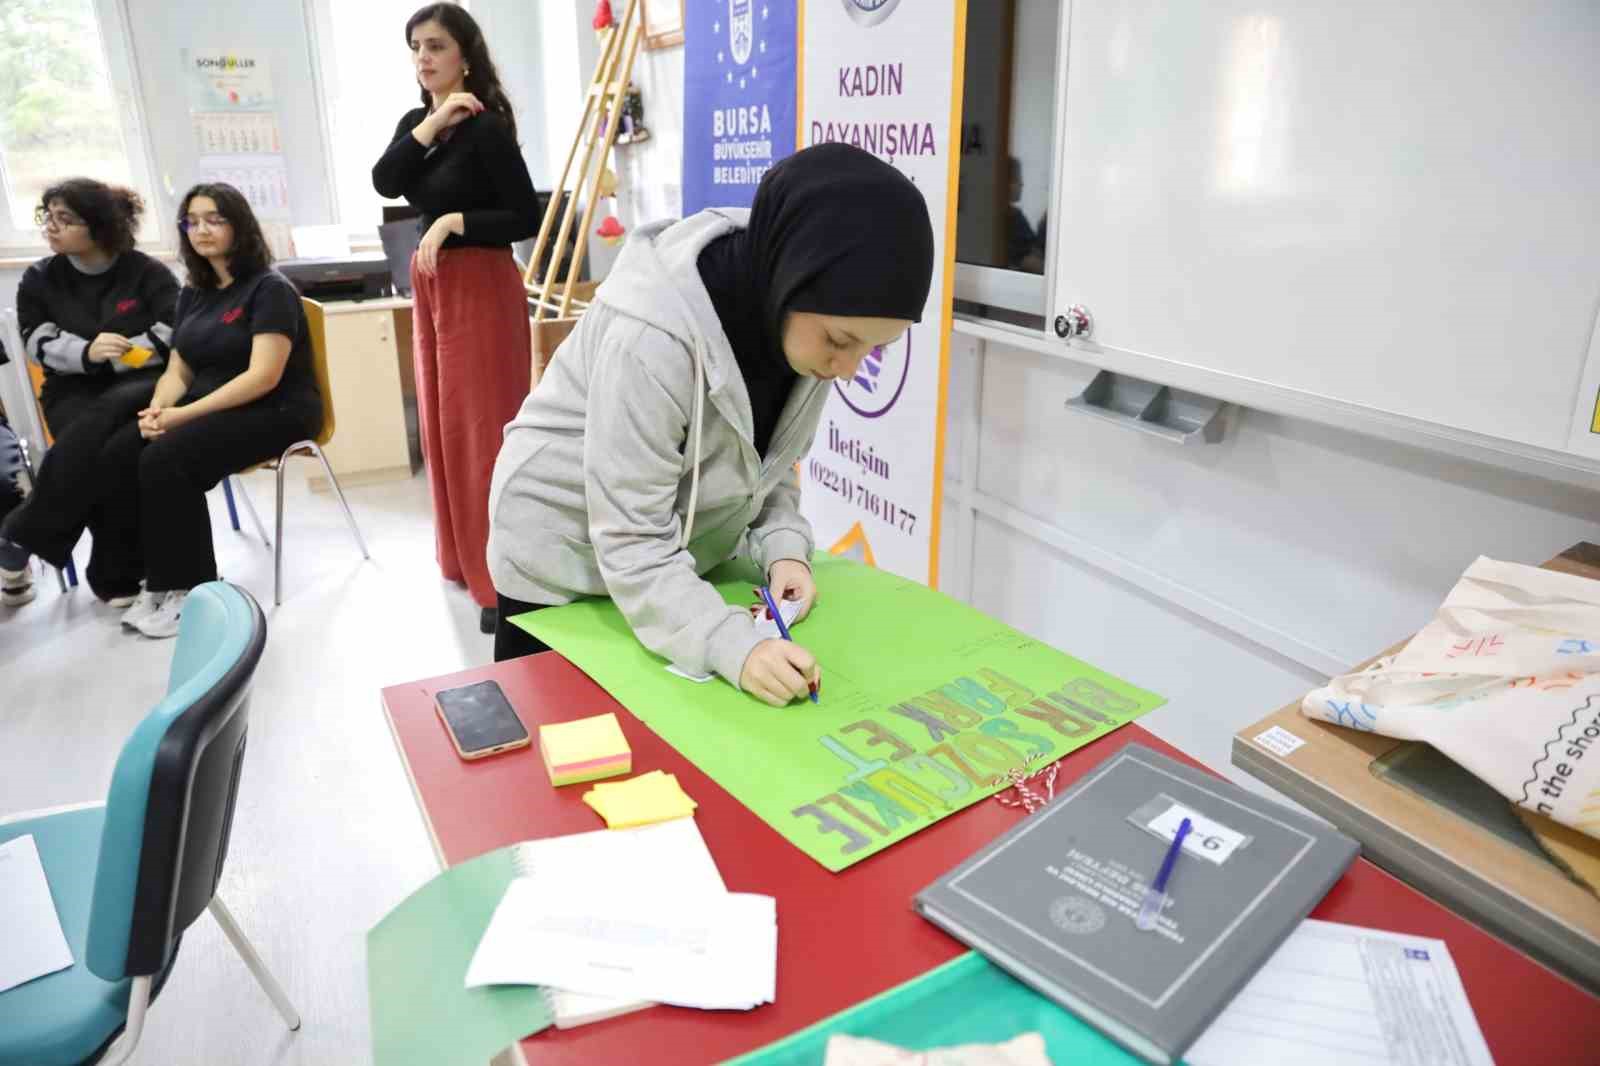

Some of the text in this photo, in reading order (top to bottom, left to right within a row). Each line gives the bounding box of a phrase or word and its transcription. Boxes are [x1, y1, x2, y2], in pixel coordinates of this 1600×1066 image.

[839, 63, 903, 97] KADIN
[713, 104, 772, 137] BURSA
[713, 134, 772, 161] BÜYÜKŞEHİR
[811, 120, 936, 165] DAYANIŞMA
[713, 161, 773, 184] BELEDİYE
[829, 420, 890, 479] İletişim
[809, 458, 917, 536] (0224) 716 11 77
[1540, 762, 1573, 798] the
[1566, 711, 1600, 760] shor
